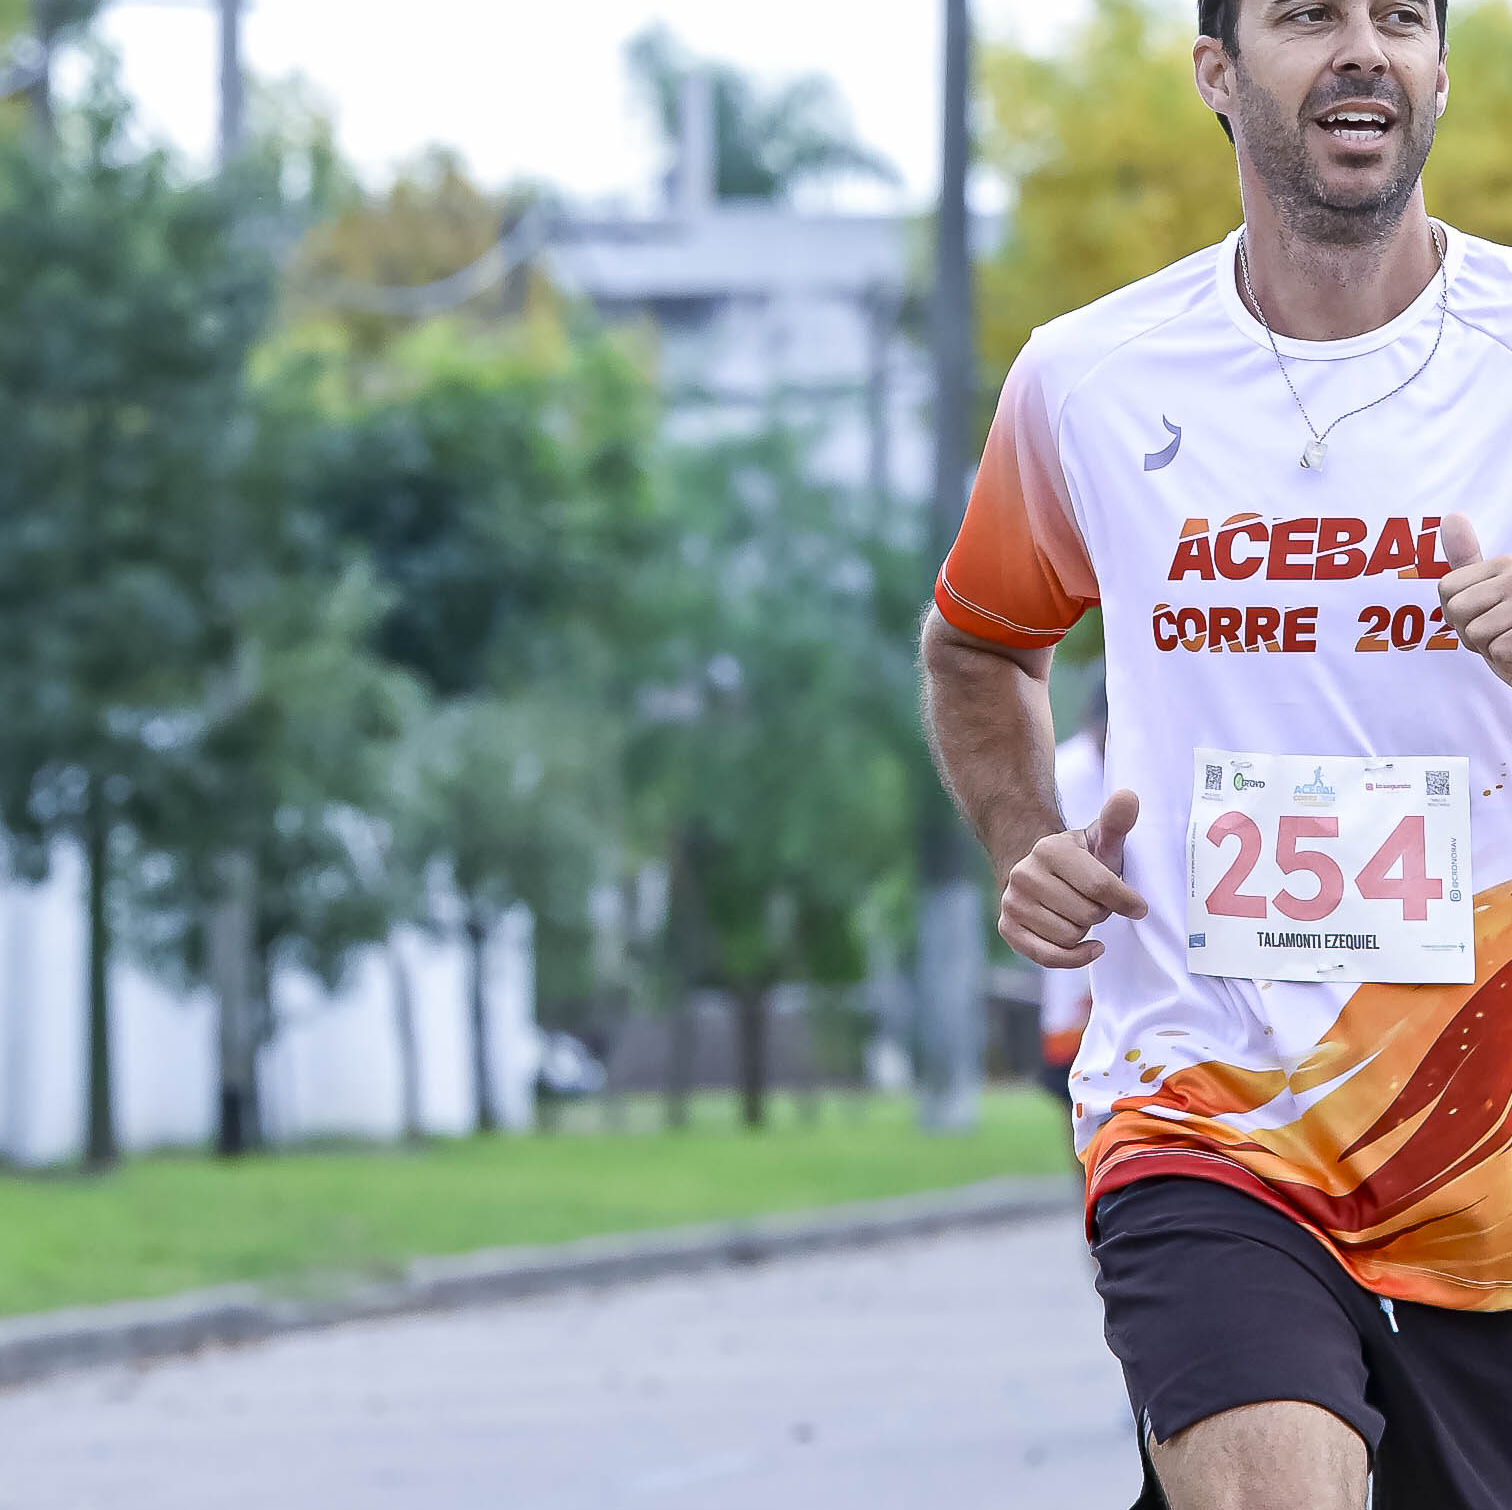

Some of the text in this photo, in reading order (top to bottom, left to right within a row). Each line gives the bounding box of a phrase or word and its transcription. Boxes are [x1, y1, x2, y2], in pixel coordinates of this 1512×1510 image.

[1167, 512, 1452, 580] ACEBAL
[1152, 603, 1459, 653] CORRE 202
[1205, 810, 1443, 922] 254
[1256, 931, 1380, 950] TALAMONTI EZEQUIEL
